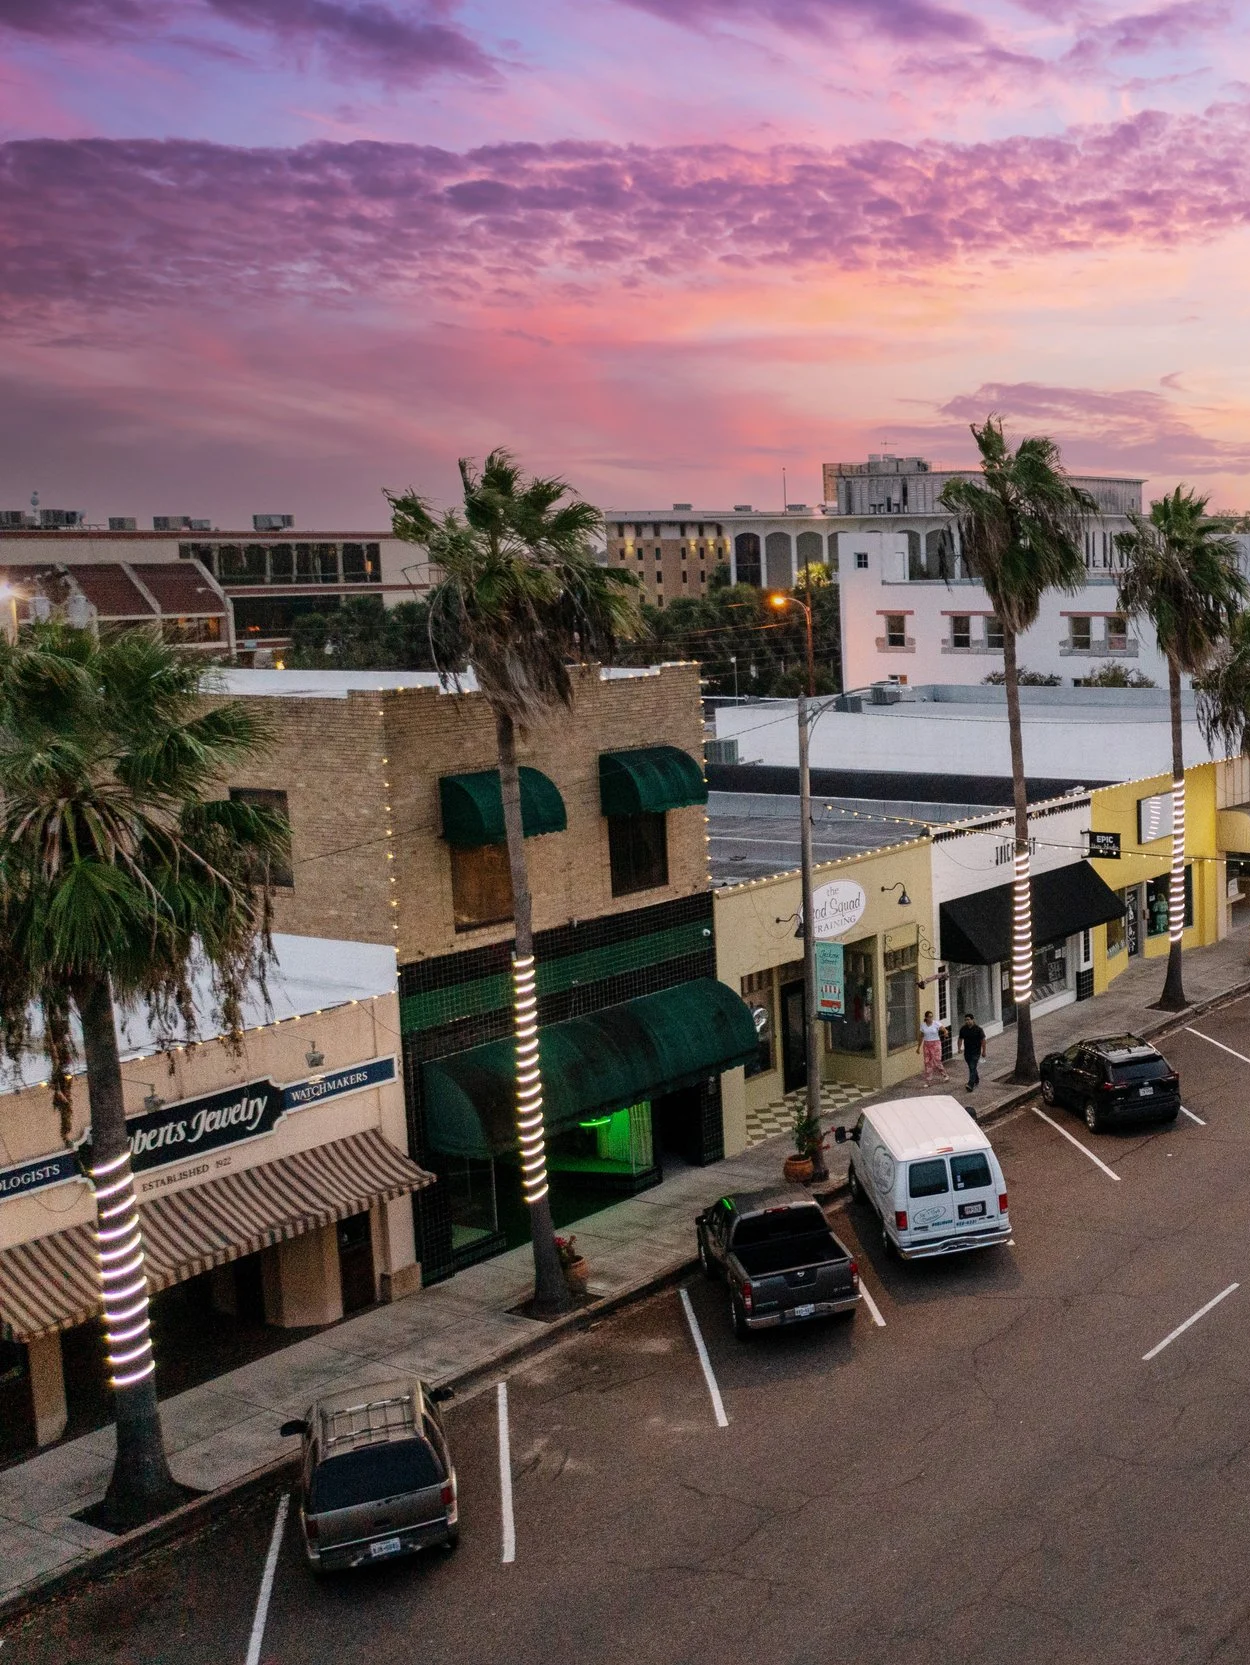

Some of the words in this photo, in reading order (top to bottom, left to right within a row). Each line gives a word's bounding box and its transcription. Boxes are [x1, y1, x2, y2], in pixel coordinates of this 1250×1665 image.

[1096, 835, 1114, 844] EPIC
[813, 901, 827, 920] od
[829, 891, 861, 918] Squad
[826, 887, 840, 897] the
[291, 1071, 369, 1101] WATCHMAKERS
[127, 1120, 188, 1155] berts
[187, 1095, 268, 1143] Jewelry
[142, 1164, 210, 1193] ESTABLISHED
[215, 1156, 232, 1169] 1922
